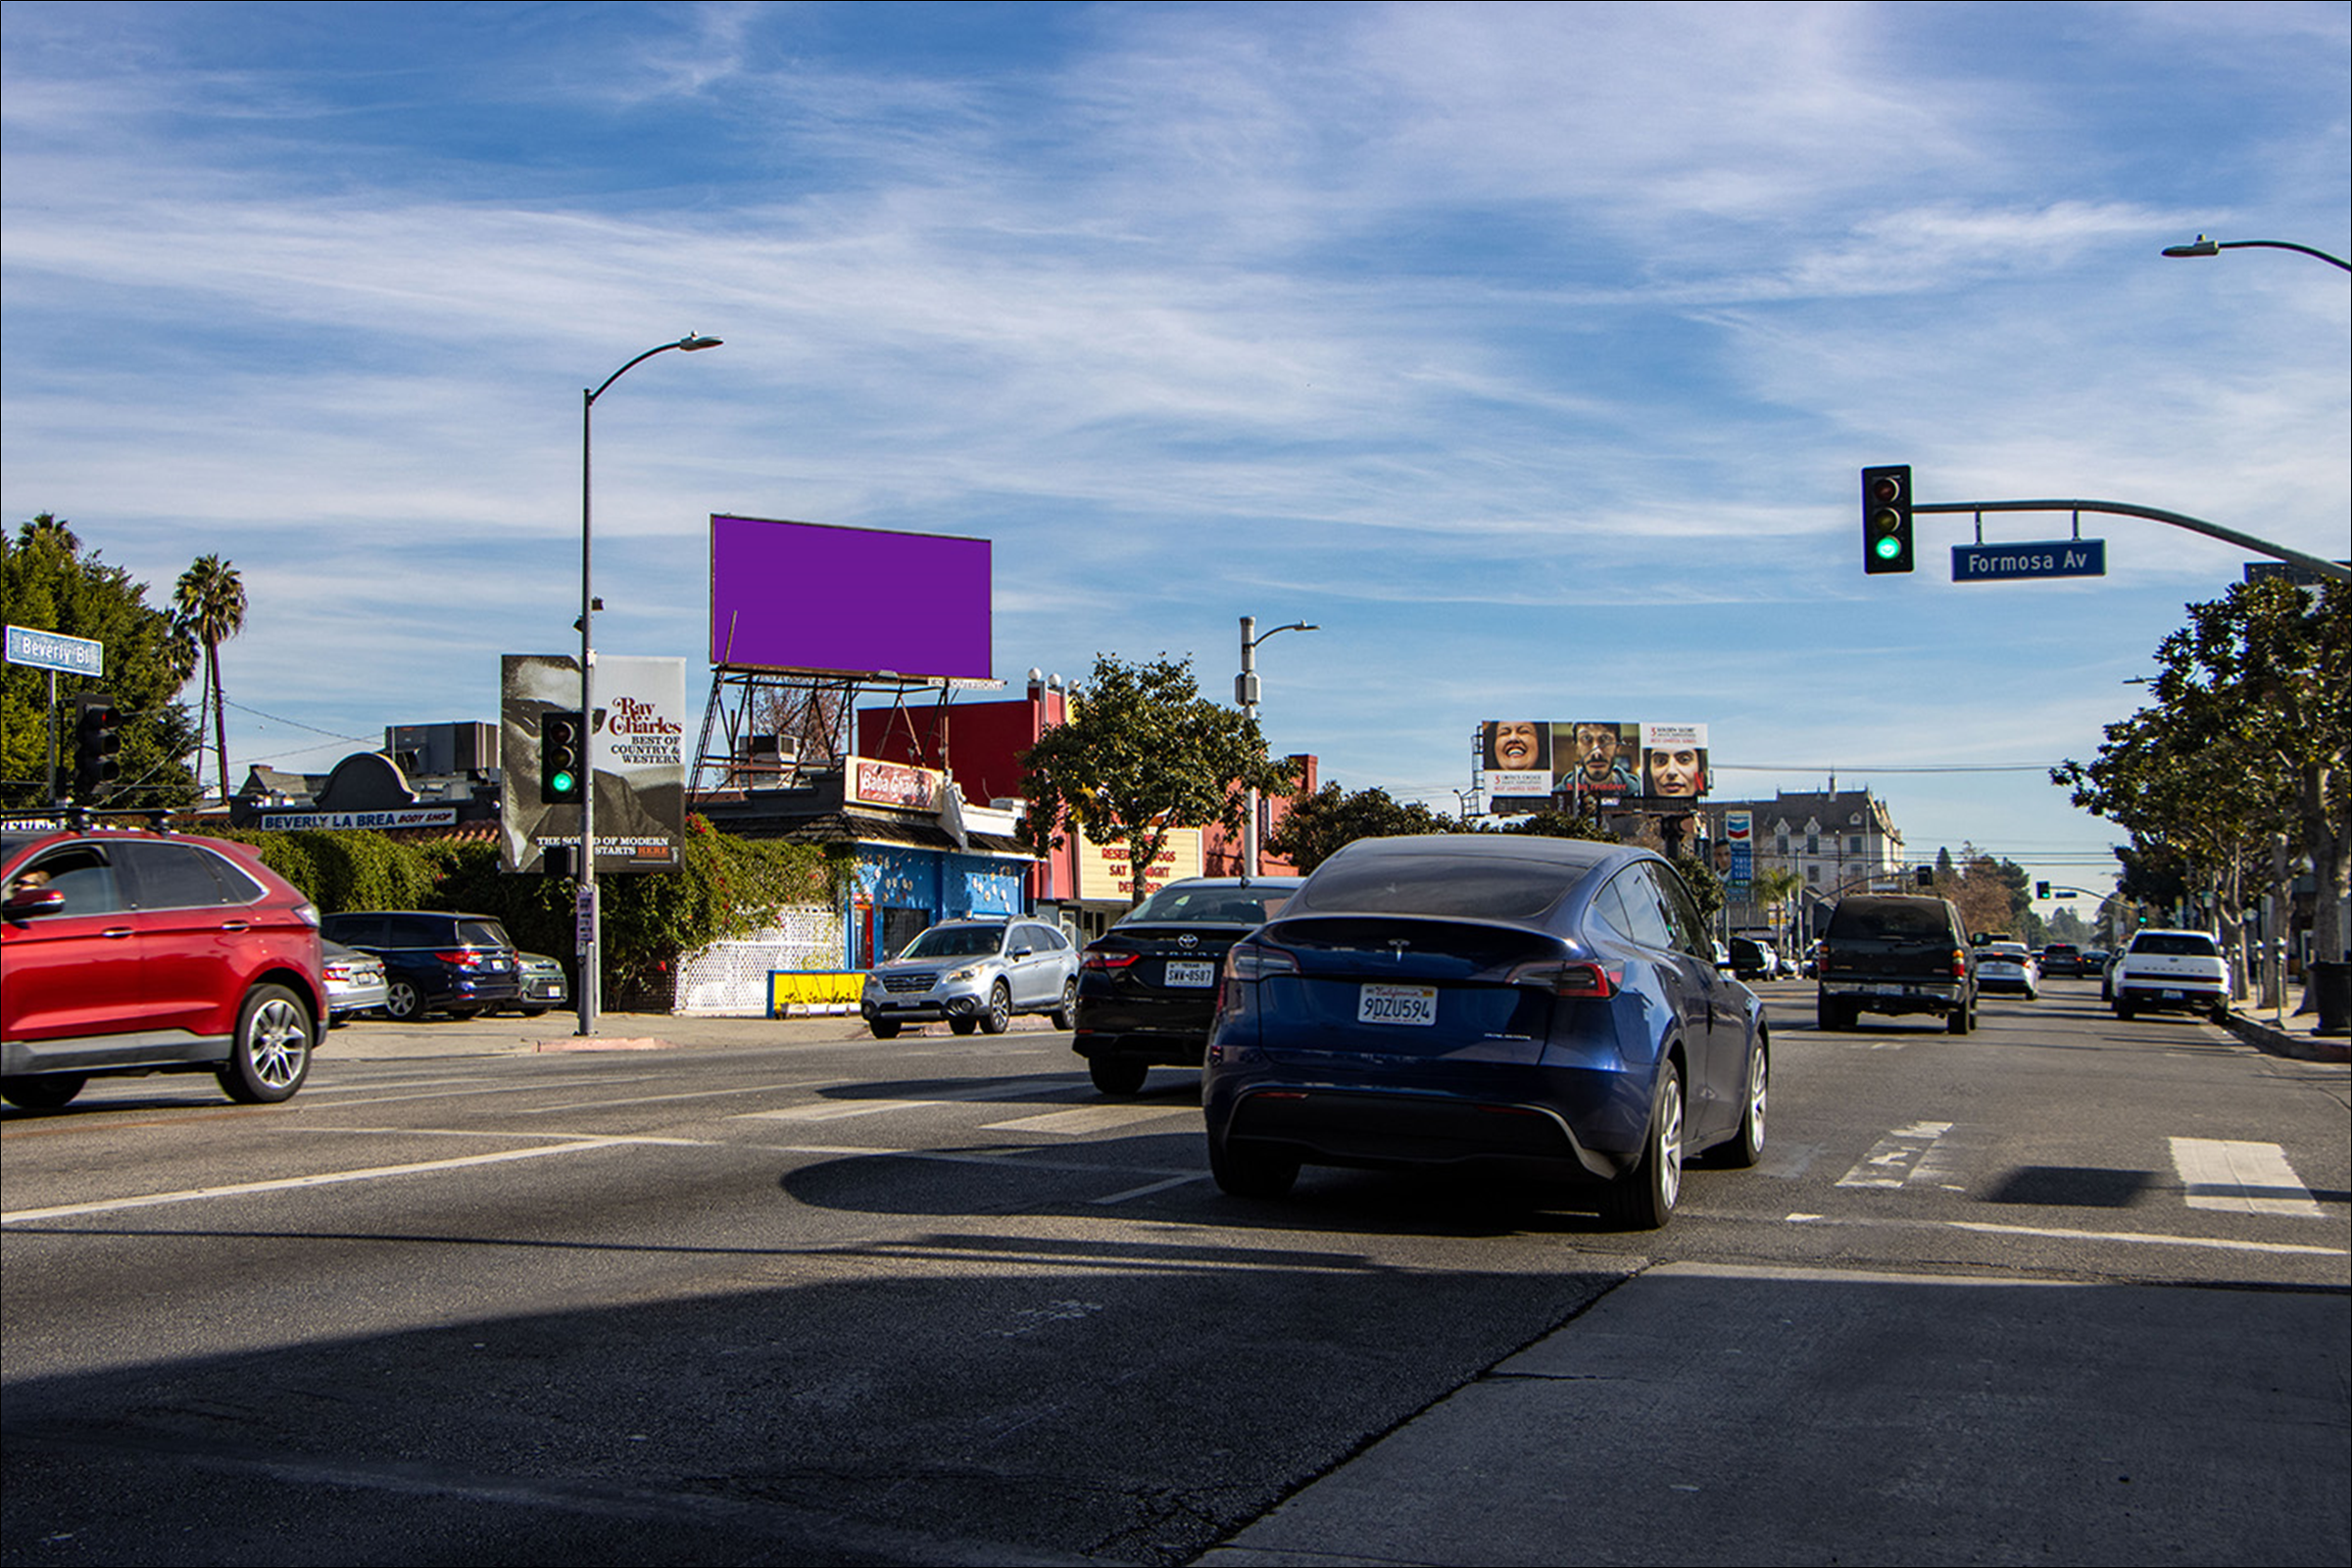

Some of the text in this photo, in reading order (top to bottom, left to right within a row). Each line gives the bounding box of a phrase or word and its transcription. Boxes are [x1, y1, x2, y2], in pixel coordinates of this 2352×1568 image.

[1968, 550, 2087, 573] Formosa Av
[22, 636, 89, 664] Beverly Bl
[612, 697, 656, 722] Ray
[609, 714, 682, 736] Charles
[632, 736, 681, 745] BEST OF
[611, 745, 680, 755] COUNTRY &
[621, 755, 681, 763] WESTERN
[265, 812, 453, 829] BEVERLY LA BREA BODY SHOP
[619, 836, 669, 847] MODERN
[594, 846, 636, 855] STARTS
[1108, 864, 1128, 876] SAT
[1363, 998, 1431, 1019] 9DZU594
